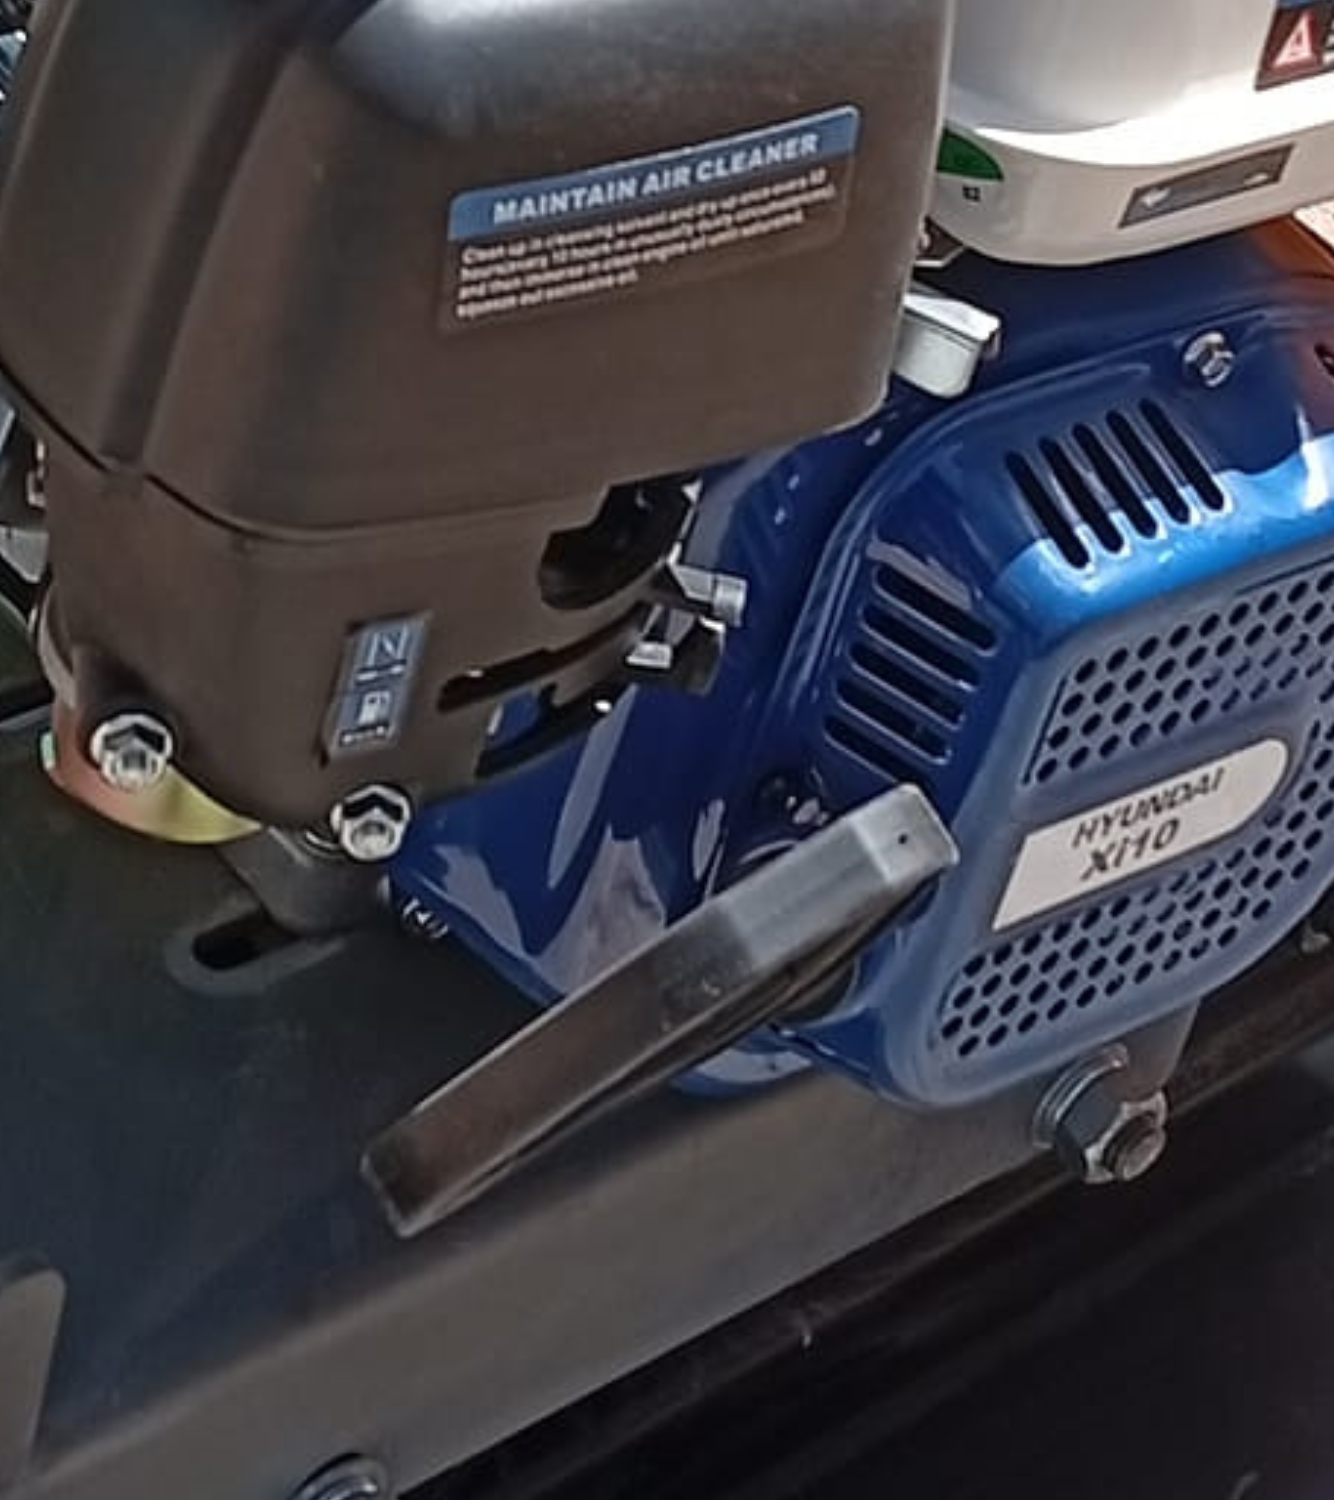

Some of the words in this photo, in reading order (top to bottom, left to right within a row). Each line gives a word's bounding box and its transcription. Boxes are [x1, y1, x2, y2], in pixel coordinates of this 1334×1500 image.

[493, 176, 637, 225] MAINTAIN
[641, 167, 692, 196] AIR
[695, 132, 820, 183] CLEANER
[1071, 766, 1225, 848] HYUNDAI
